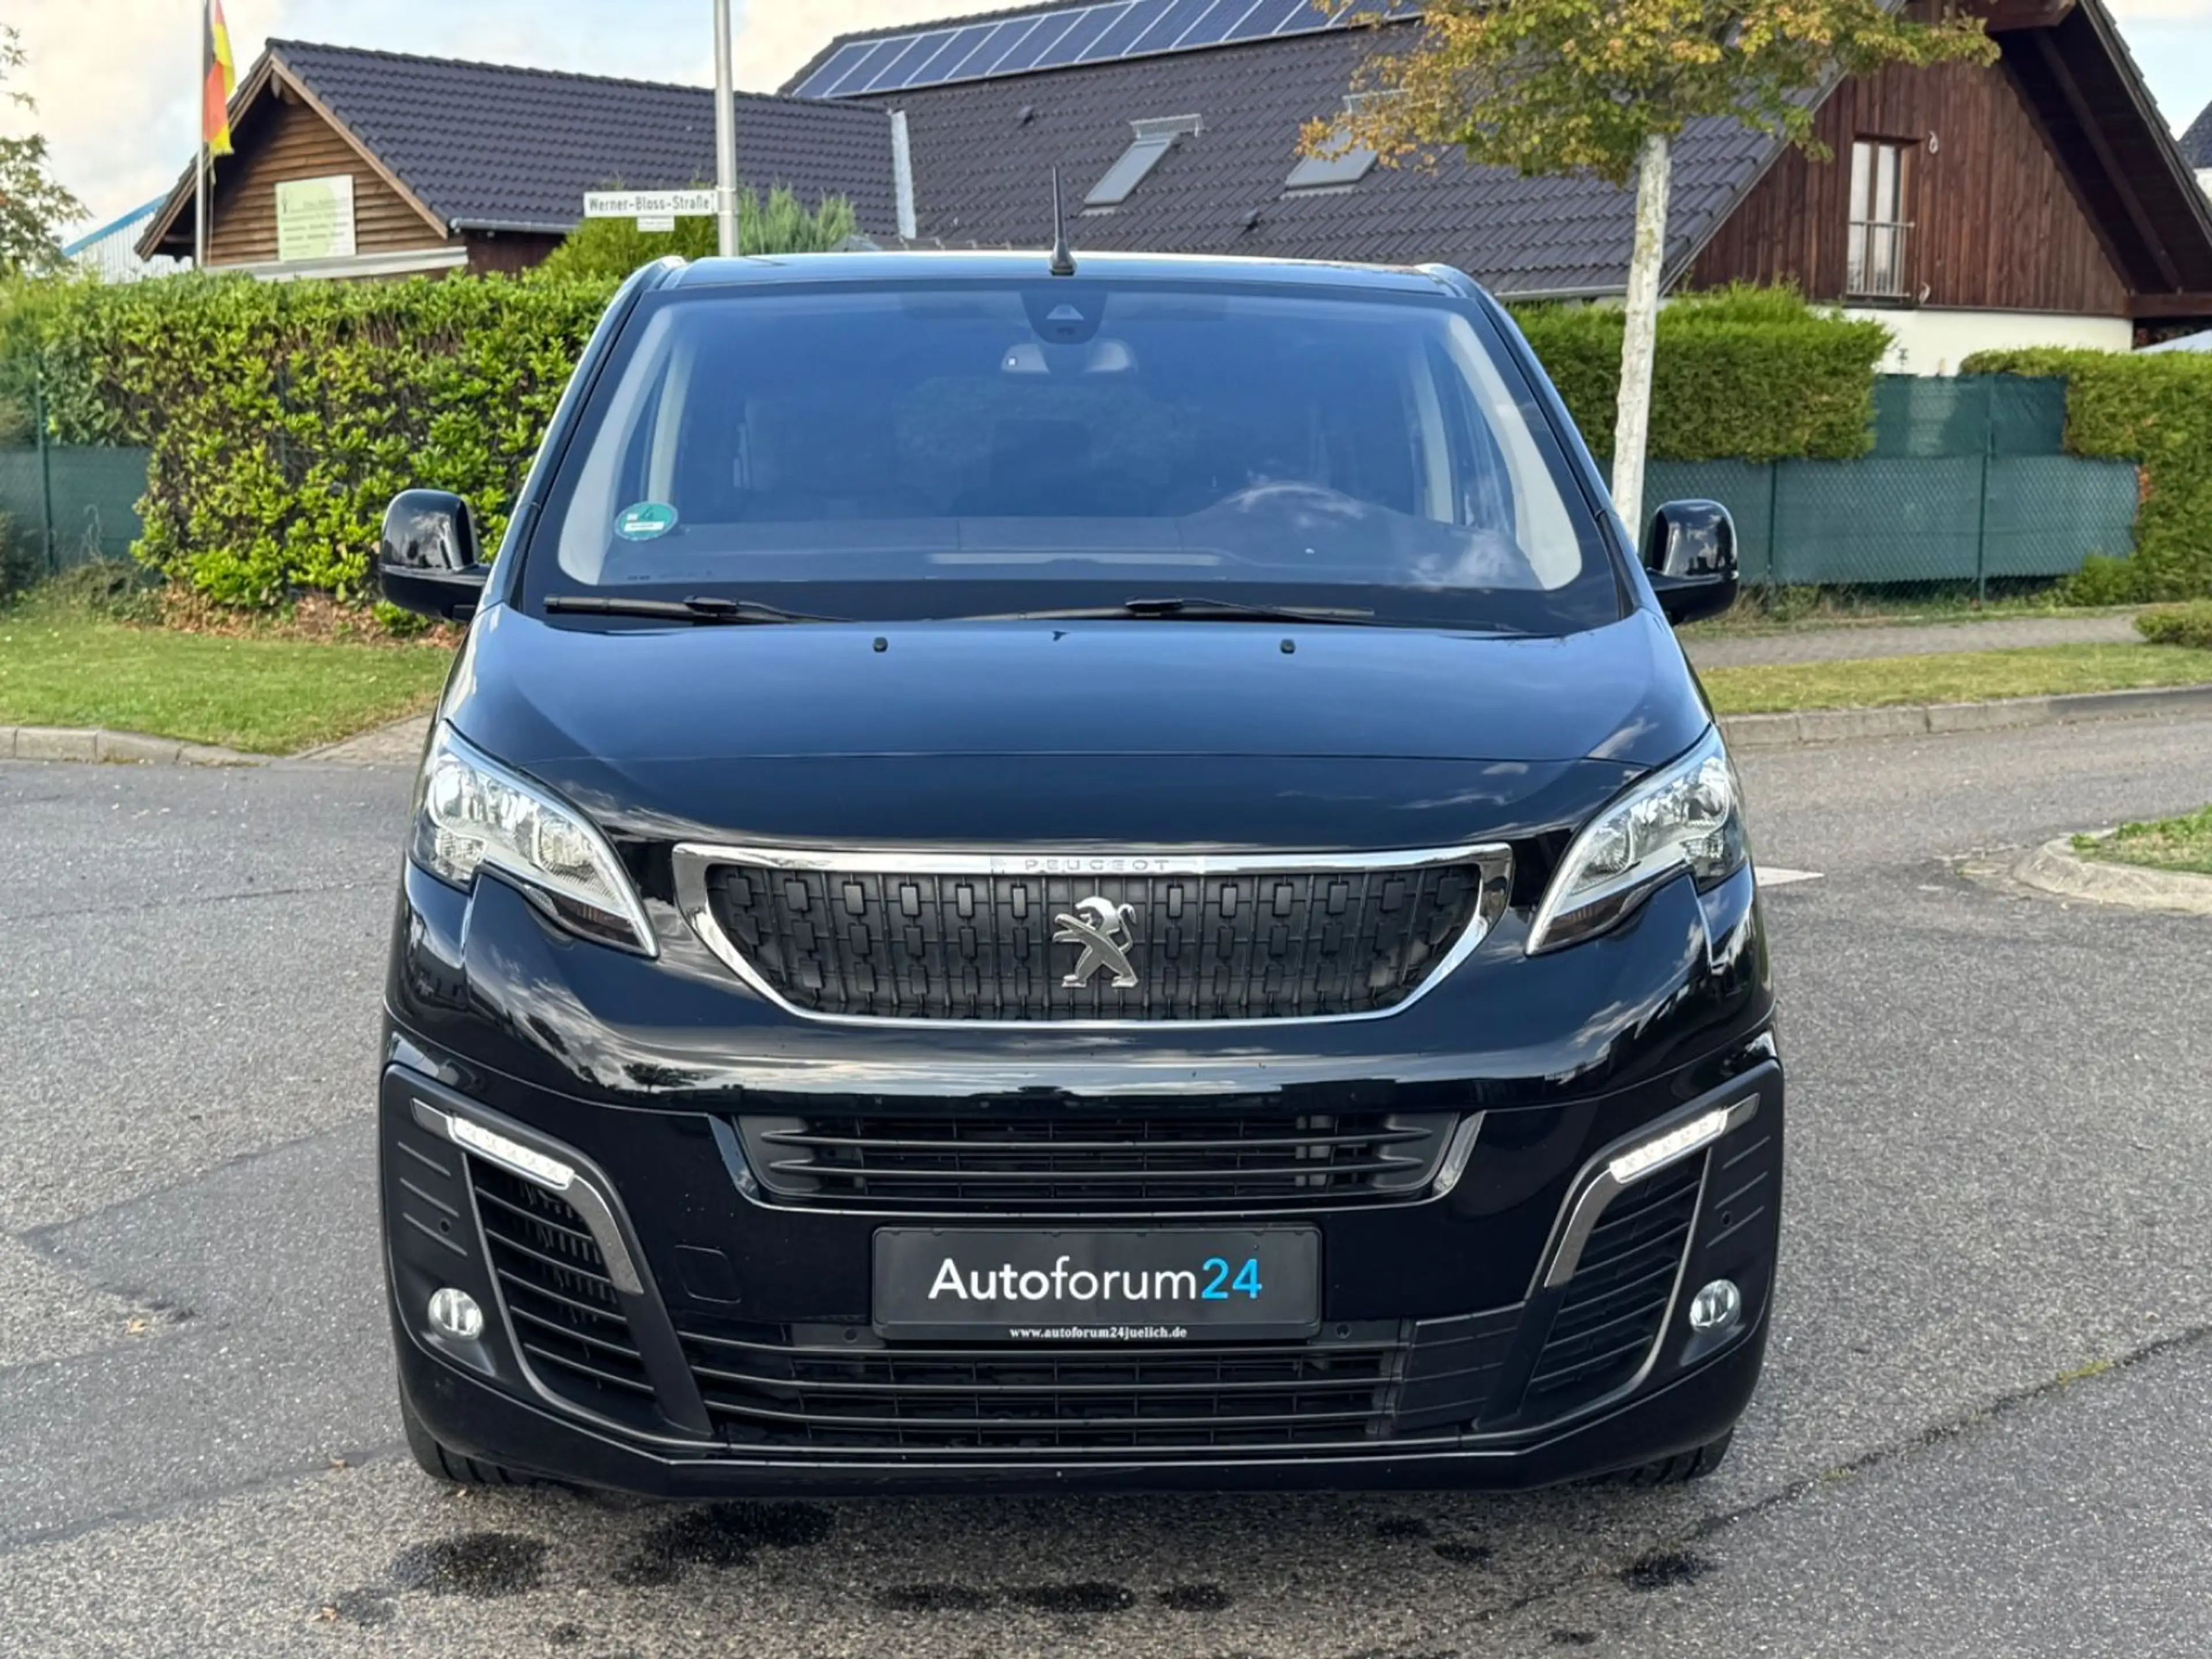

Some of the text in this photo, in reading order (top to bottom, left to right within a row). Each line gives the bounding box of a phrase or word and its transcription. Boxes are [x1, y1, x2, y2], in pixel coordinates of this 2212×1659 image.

[1025, 859, 1169, 871] PEUGEOT
[927, 1255, 1263, 1300] Autoforum24
[1009, 1325, 1188, 1340] www.autoforum24juelich.de
